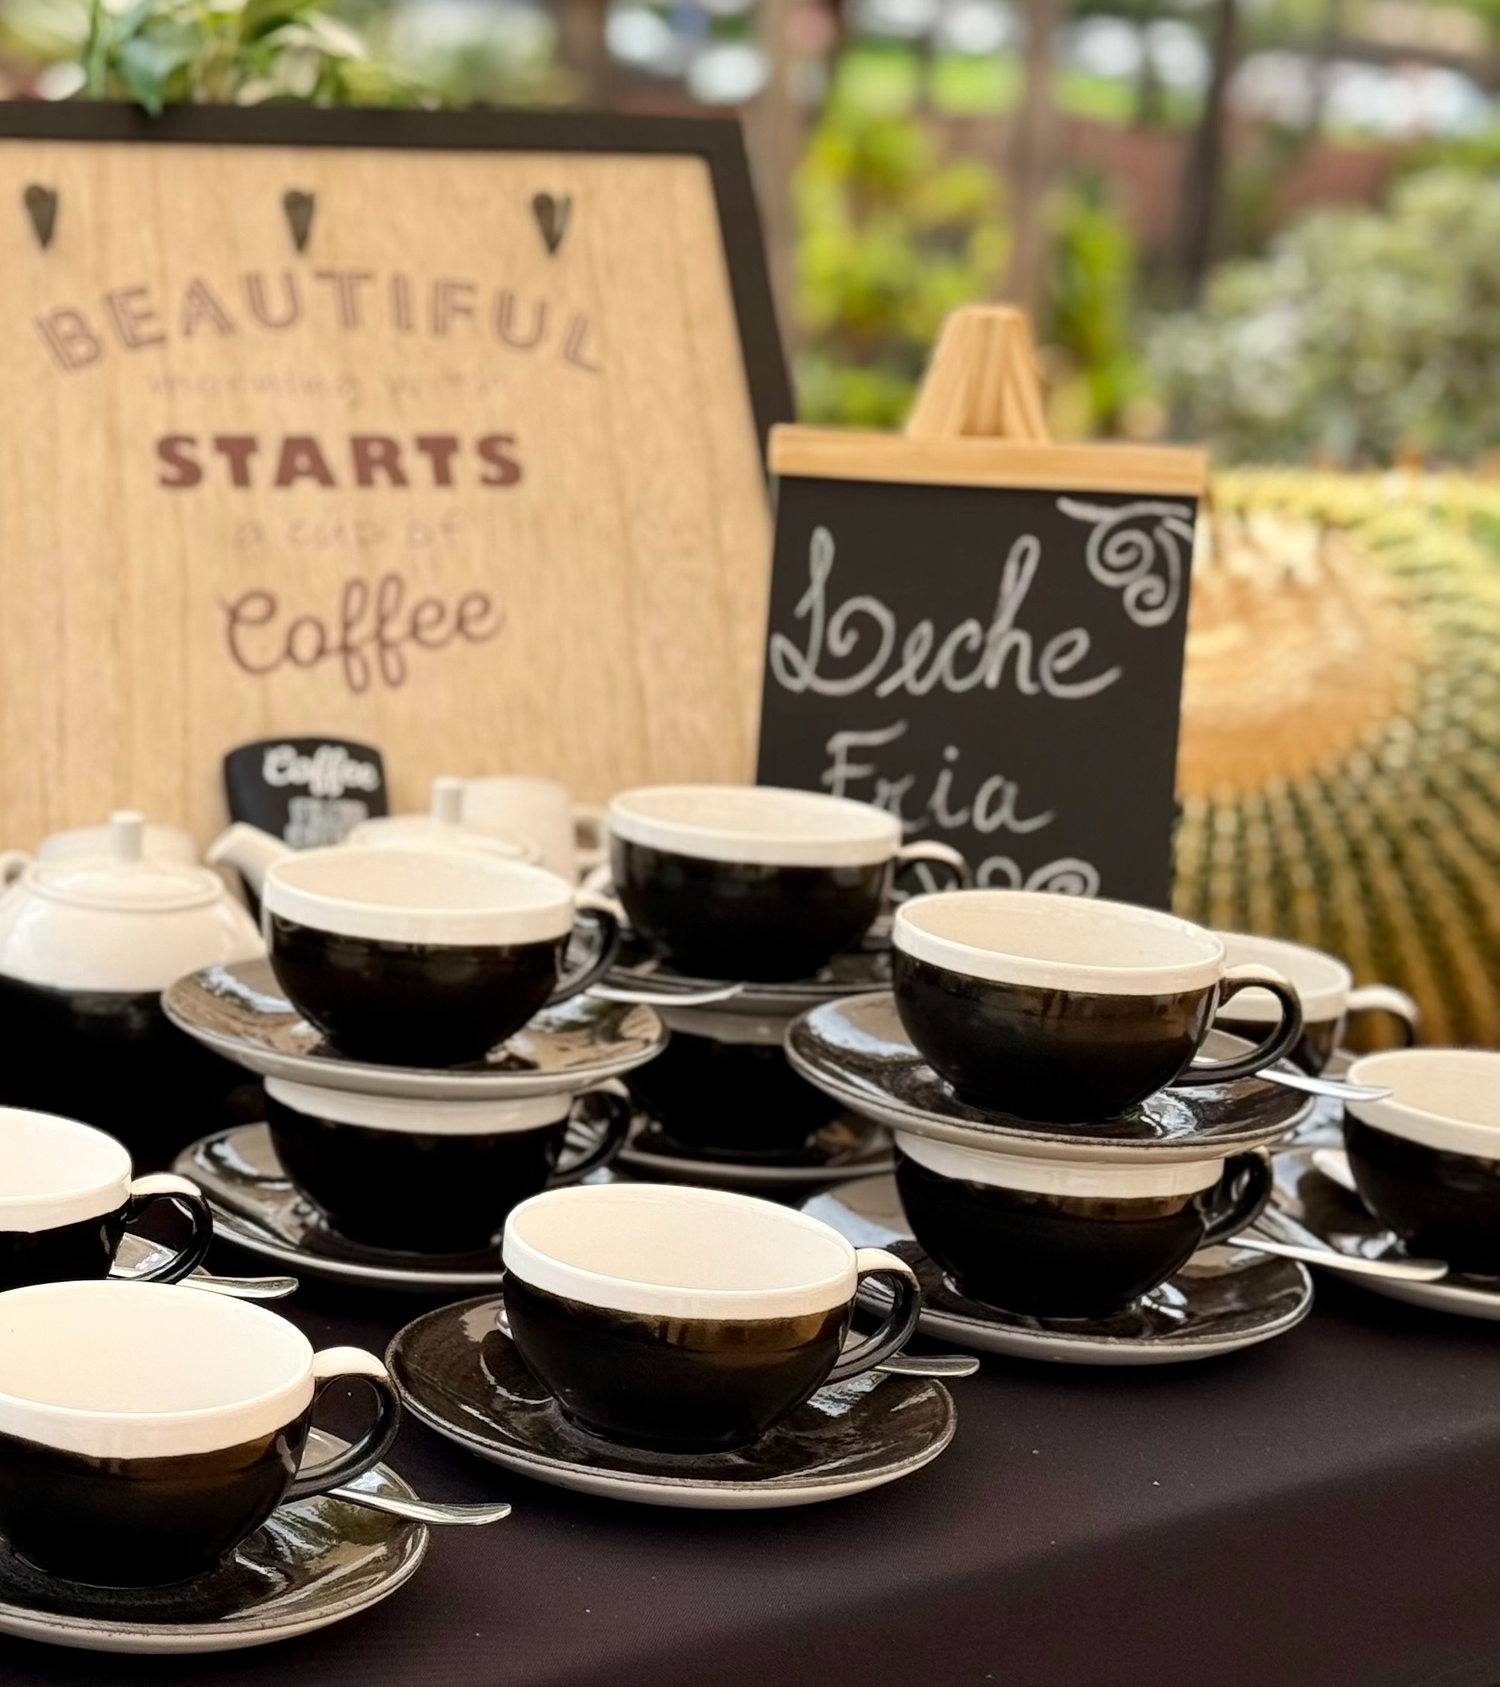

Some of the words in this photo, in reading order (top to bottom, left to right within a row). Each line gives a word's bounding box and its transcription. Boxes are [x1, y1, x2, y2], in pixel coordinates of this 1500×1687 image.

[36, 267, 605, 376] BEAUTIFUL
[154, 431, 525, 490] STARTS
[219, 571, 506, 695] Coffee
[769, 525, 1124, 699] Leche
[261, 743, 381, 799] Coffee
